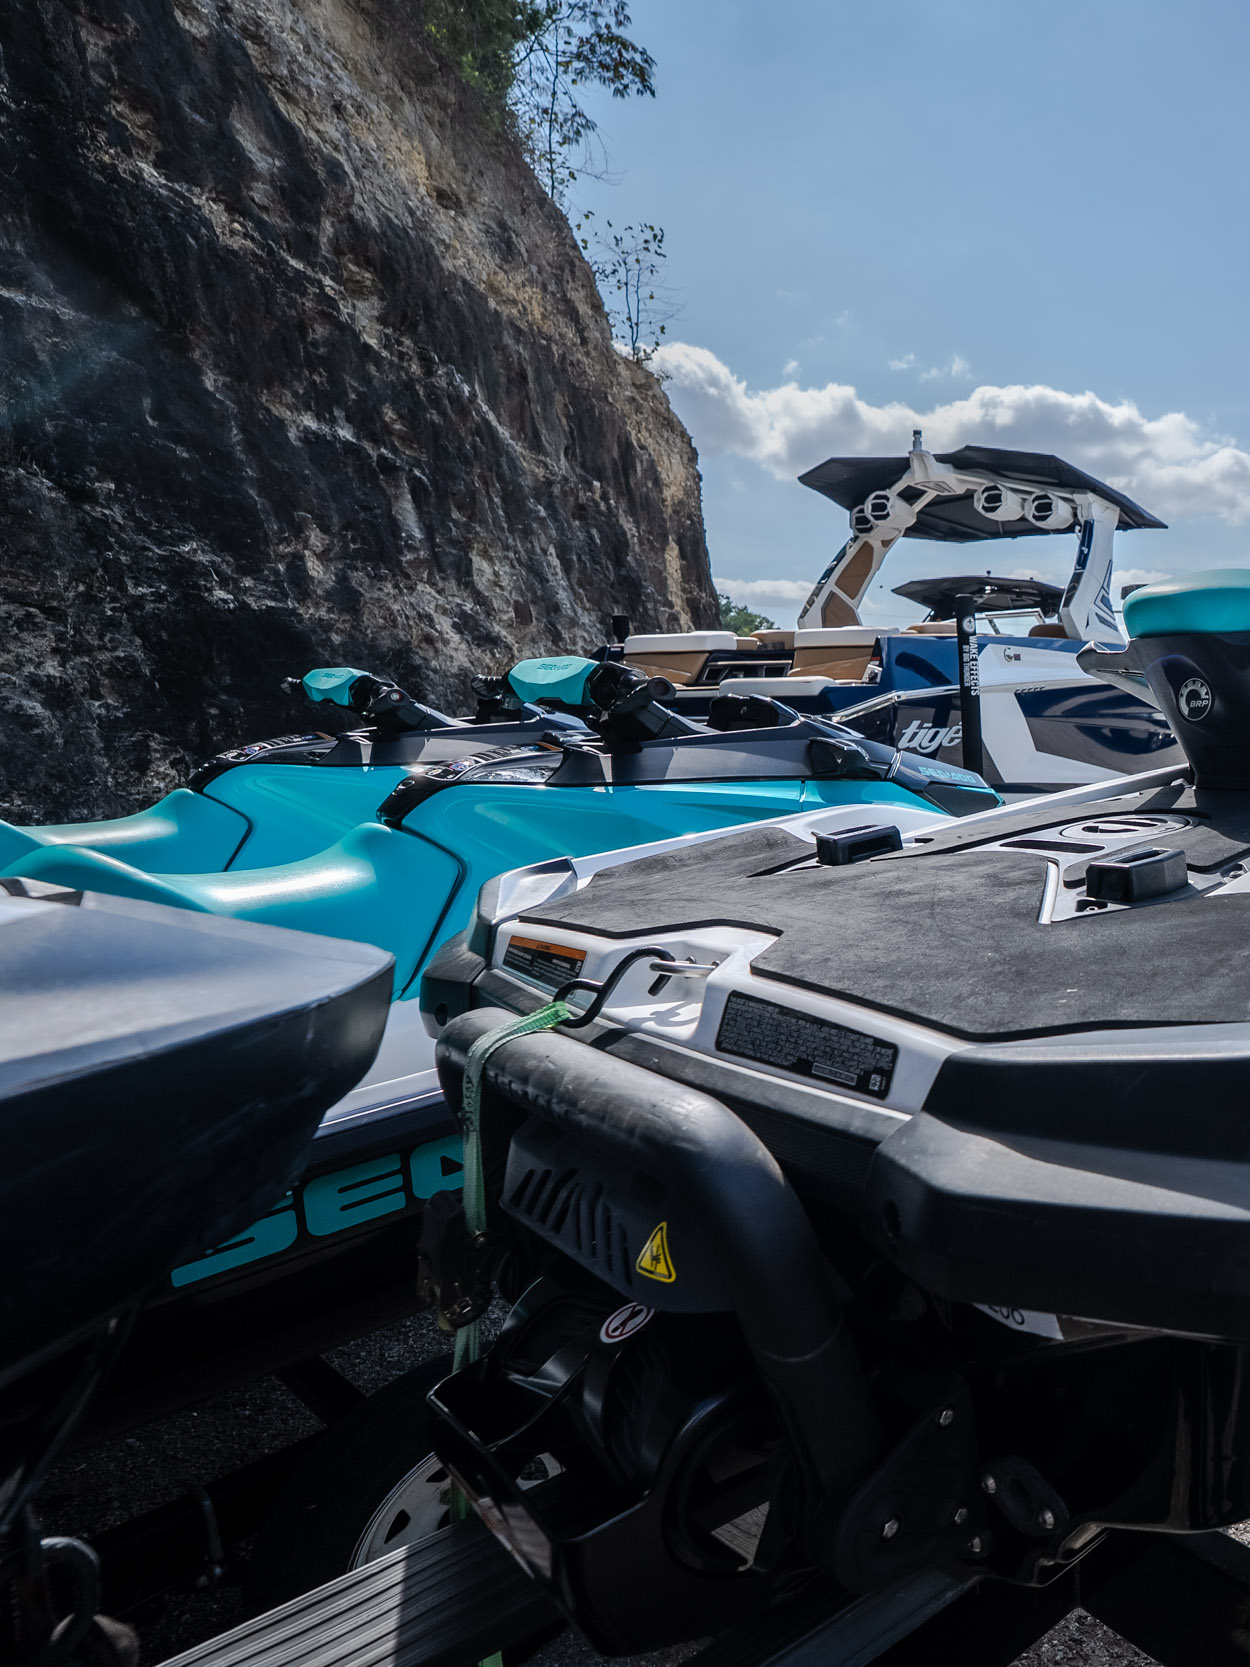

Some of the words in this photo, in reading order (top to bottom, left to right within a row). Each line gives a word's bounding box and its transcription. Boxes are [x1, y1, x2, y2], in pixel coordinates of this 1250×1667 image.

[968, 635, 979, 660] WAKE
[969, 661, 980, 696] EFFECTS
[1190, 700, 1209, 708] BRP
